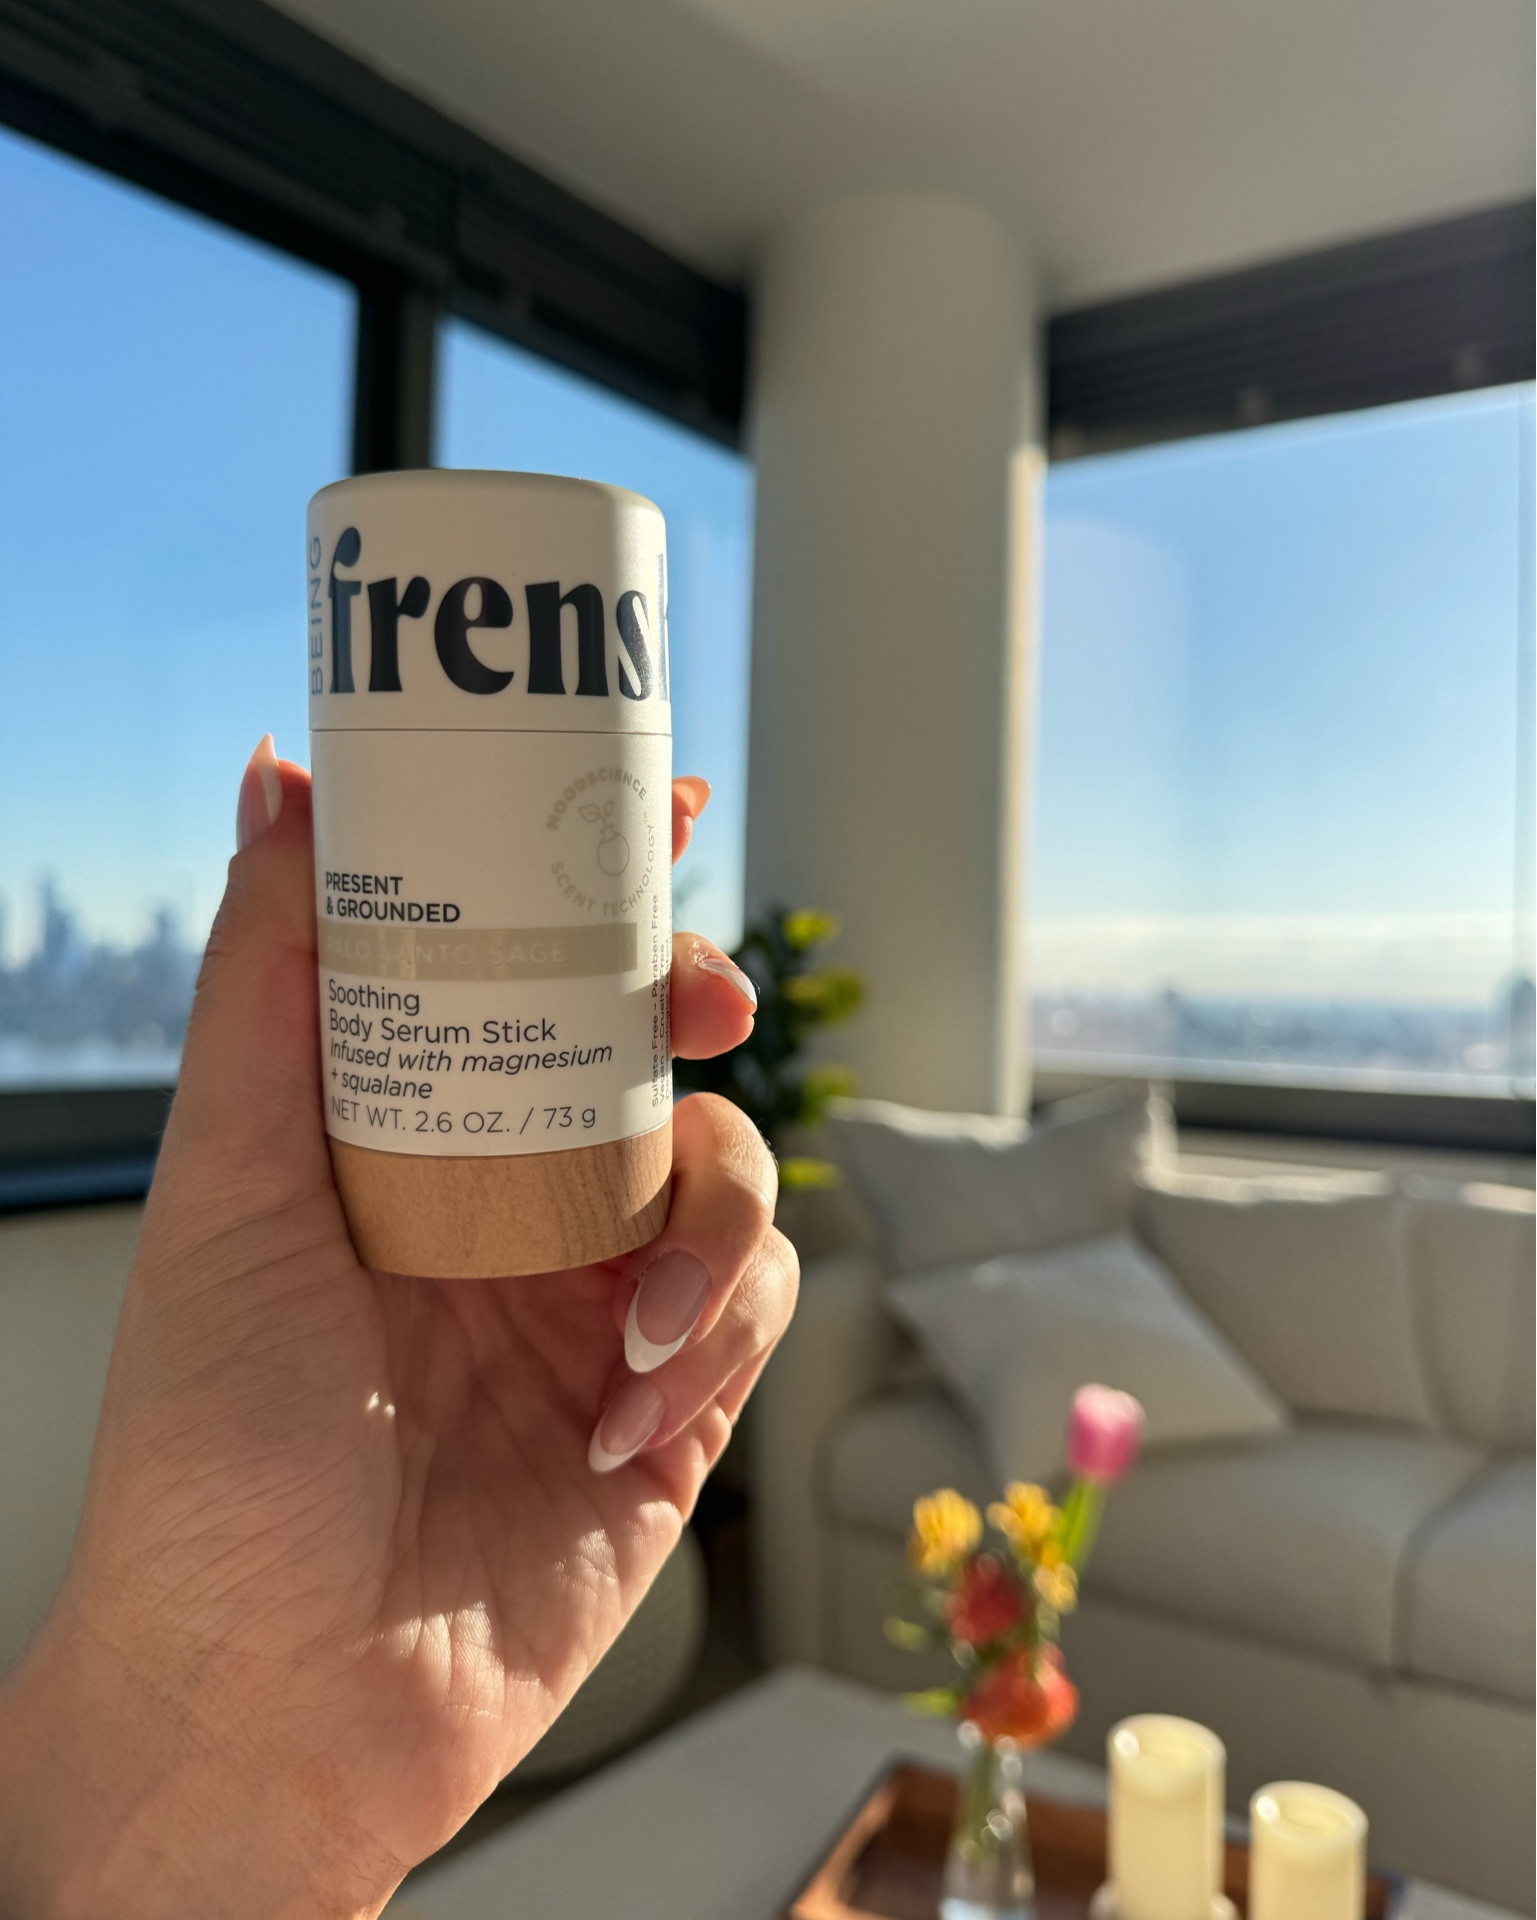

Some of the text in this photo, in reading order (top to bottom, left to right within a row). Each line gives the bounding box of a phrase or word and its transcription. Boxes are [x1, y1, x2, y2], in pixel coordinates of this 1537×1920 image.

[310, 536, 324, 696] BEING
[326, 871, 403, 896] PRESENT
[552, 862, 597, 912] SCENT
[326, 896, 461, 923] & GROUNDED
[488, 942, 568, 966] SAGE
[329, 978, 420, 1016] Soothing
[330, 1008, 557, 1044] Body Serum Stick
[330, 1037, 613, 1076] Infused with magnesium
[331, 1067, 433, 1099] + squalane
[332, 1095, 597, 1136] NET WT. 2.6 OZ. / 73 g
